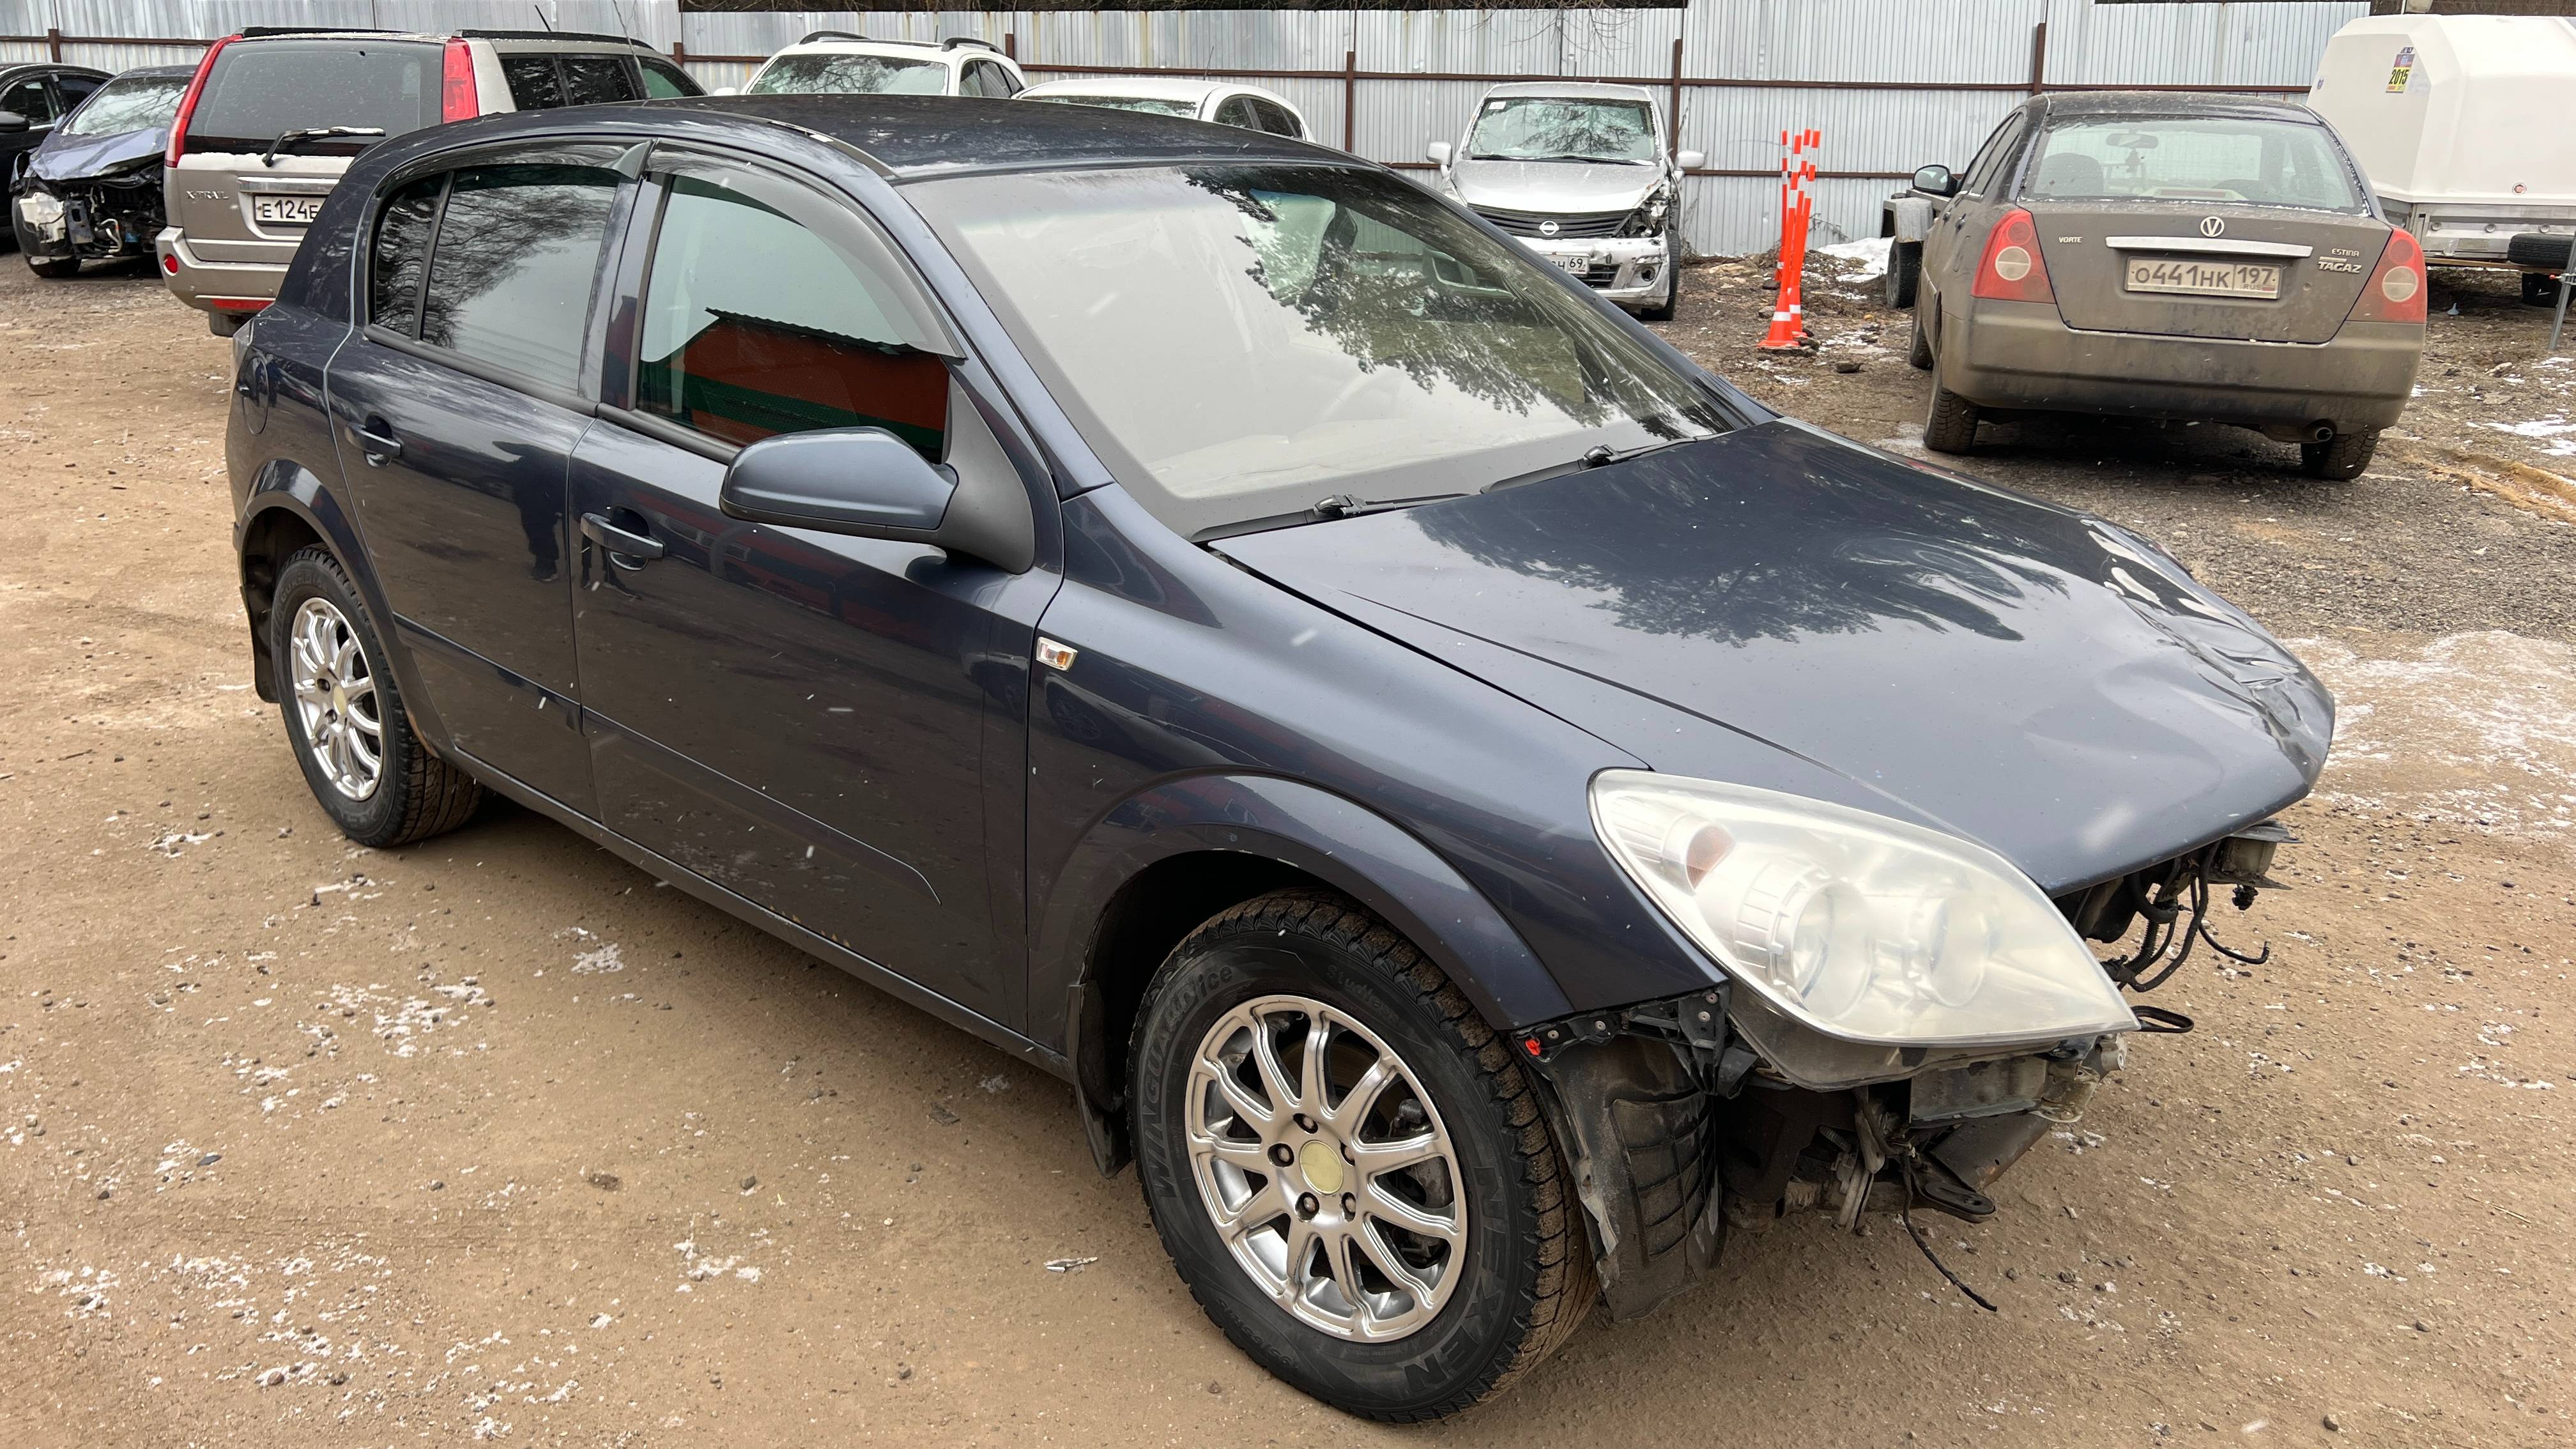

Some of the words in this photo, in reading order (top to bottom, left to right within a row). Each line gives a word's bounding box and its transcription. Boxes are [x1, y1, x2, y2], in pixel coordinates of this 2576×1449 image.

[2388, 69, 2410, 85] 2015
[186, 190, 229, 200] X-TRAIL
[2331, 248, 2360, 257] ESTINA
[1569, 257, 1583, 268] 69
[2317, 261, 2363, 274] TAGAZ
[2237, 266, 2274, 284] 197
[1404, 1165, 1510, 1393] NEXEN
